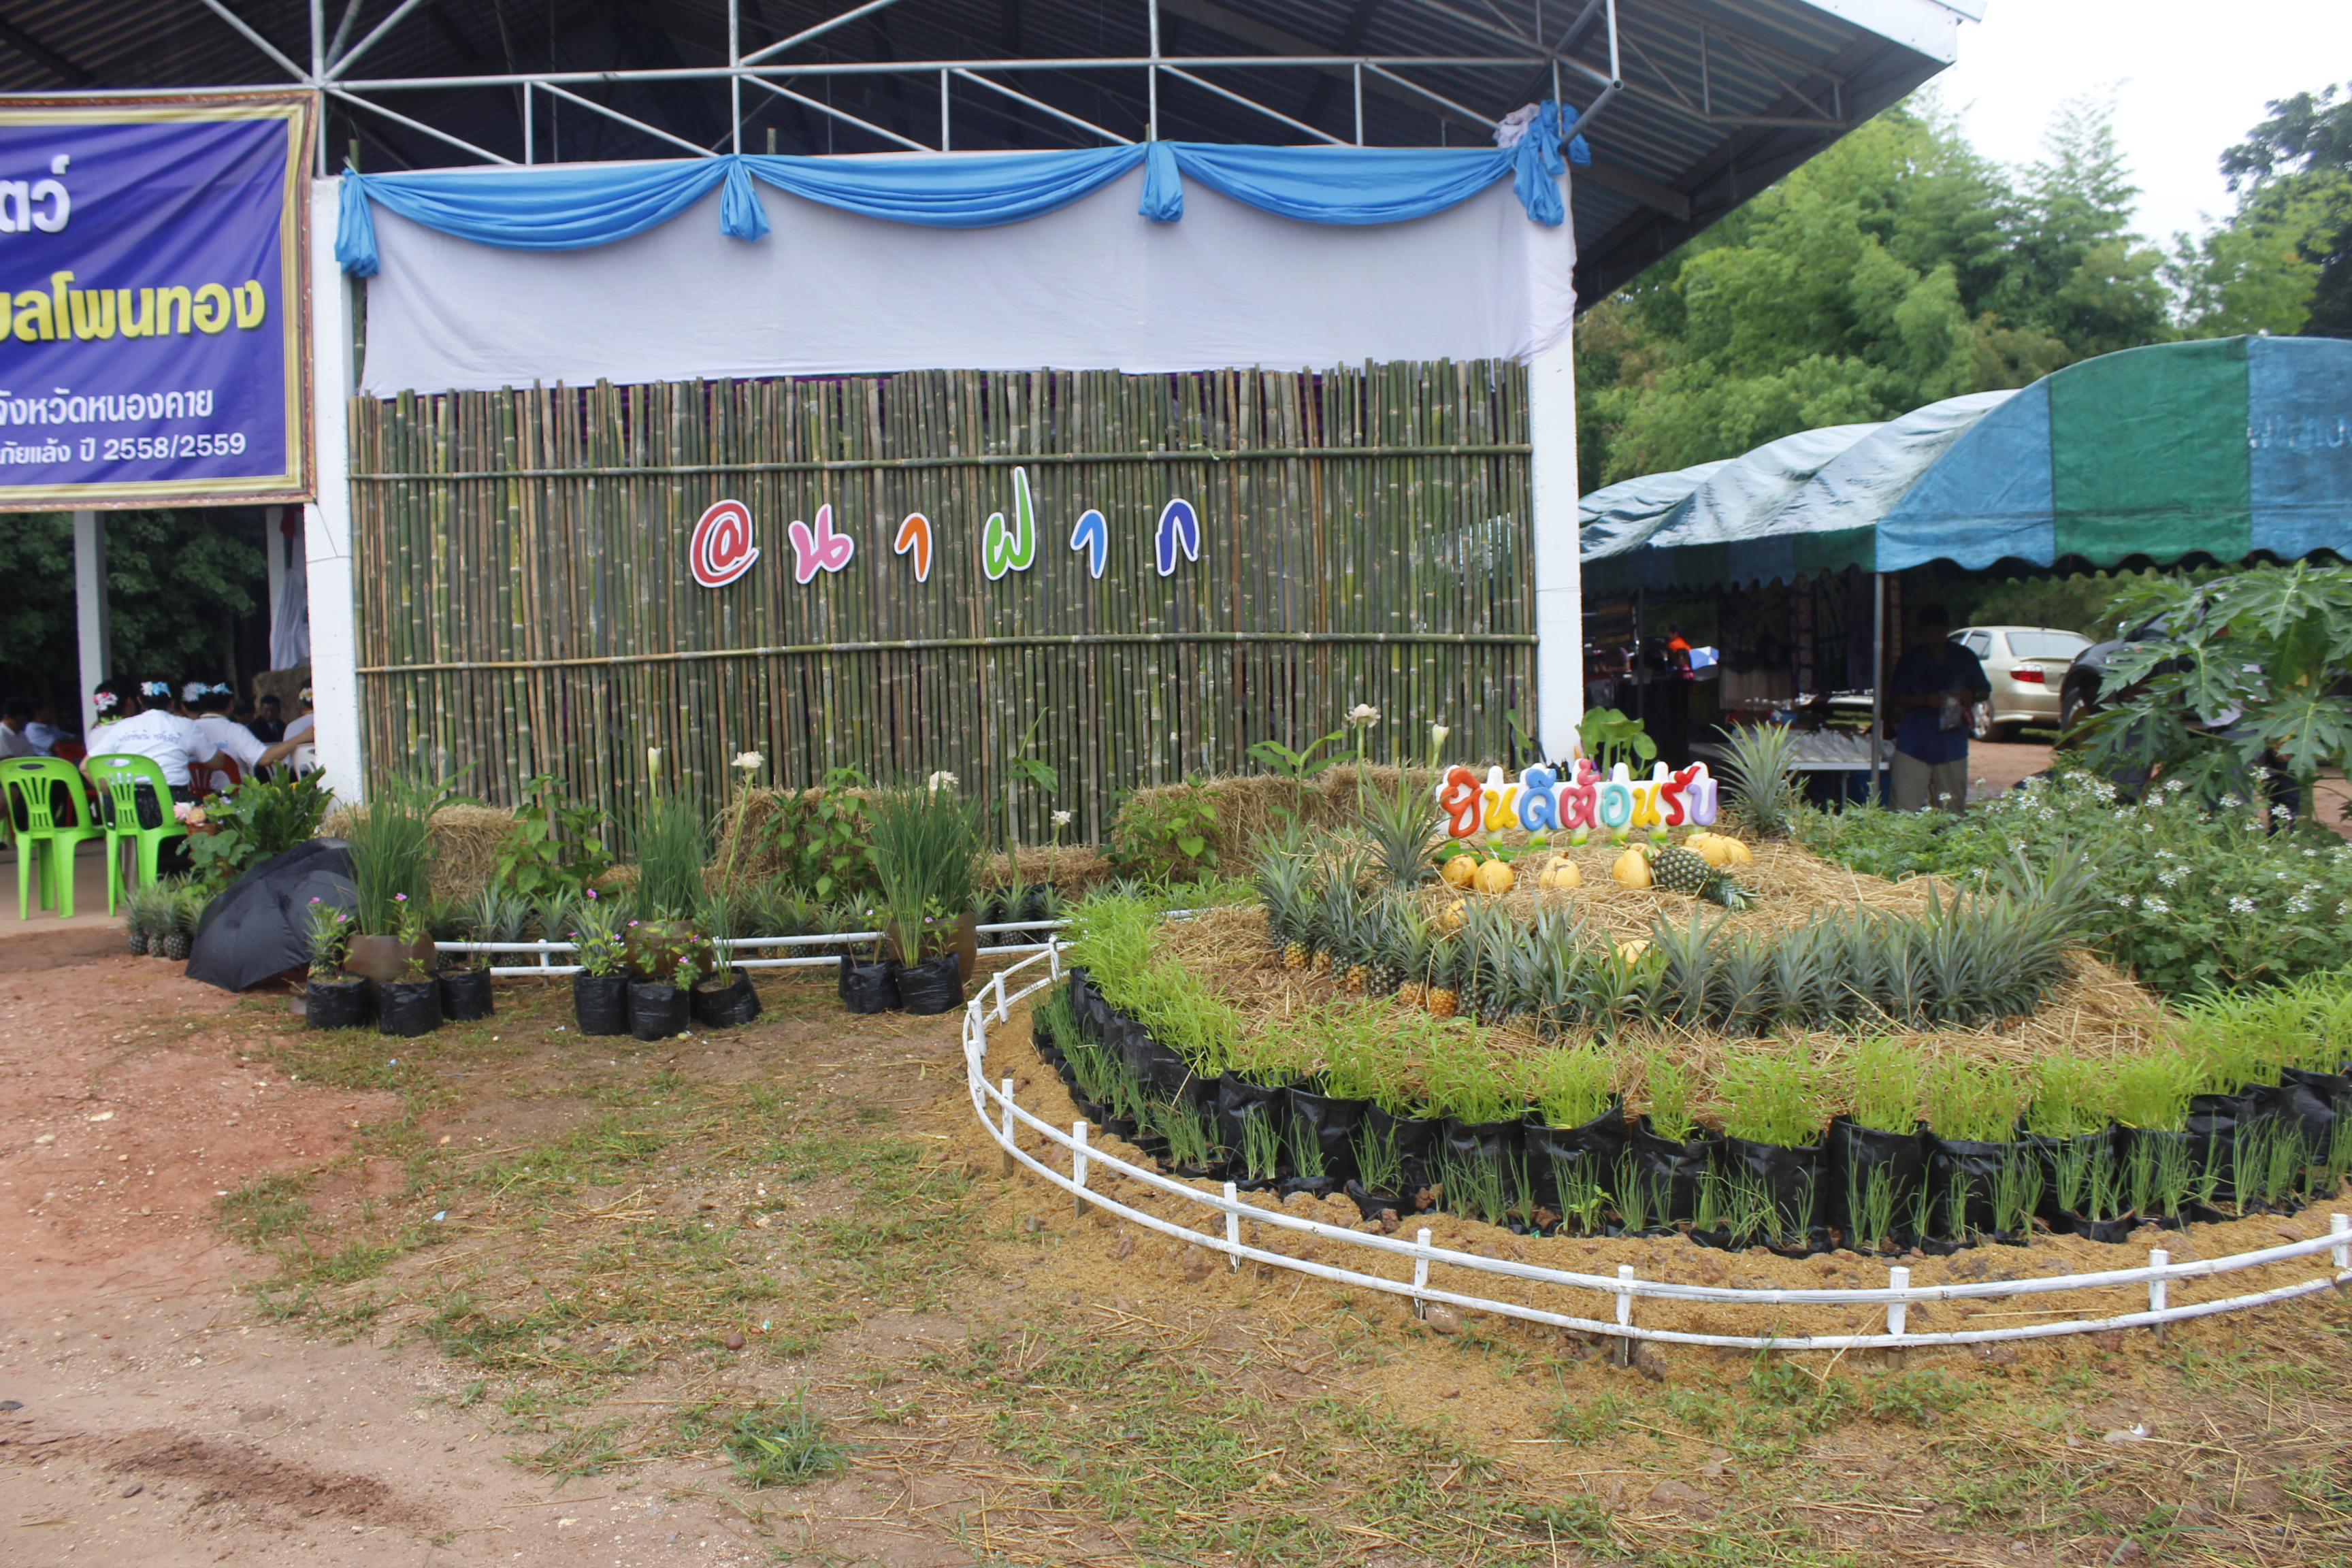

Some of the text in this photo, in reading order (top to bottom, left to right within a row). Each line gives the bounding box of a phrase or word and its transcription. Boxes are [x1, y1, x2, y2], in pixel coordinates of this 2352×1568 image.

[80, 437, 96, 462] ปี
[103, 432, 246, 461] 2558/2559
[1440, 758, 1718, 838] ยินดีต้อนรับ
